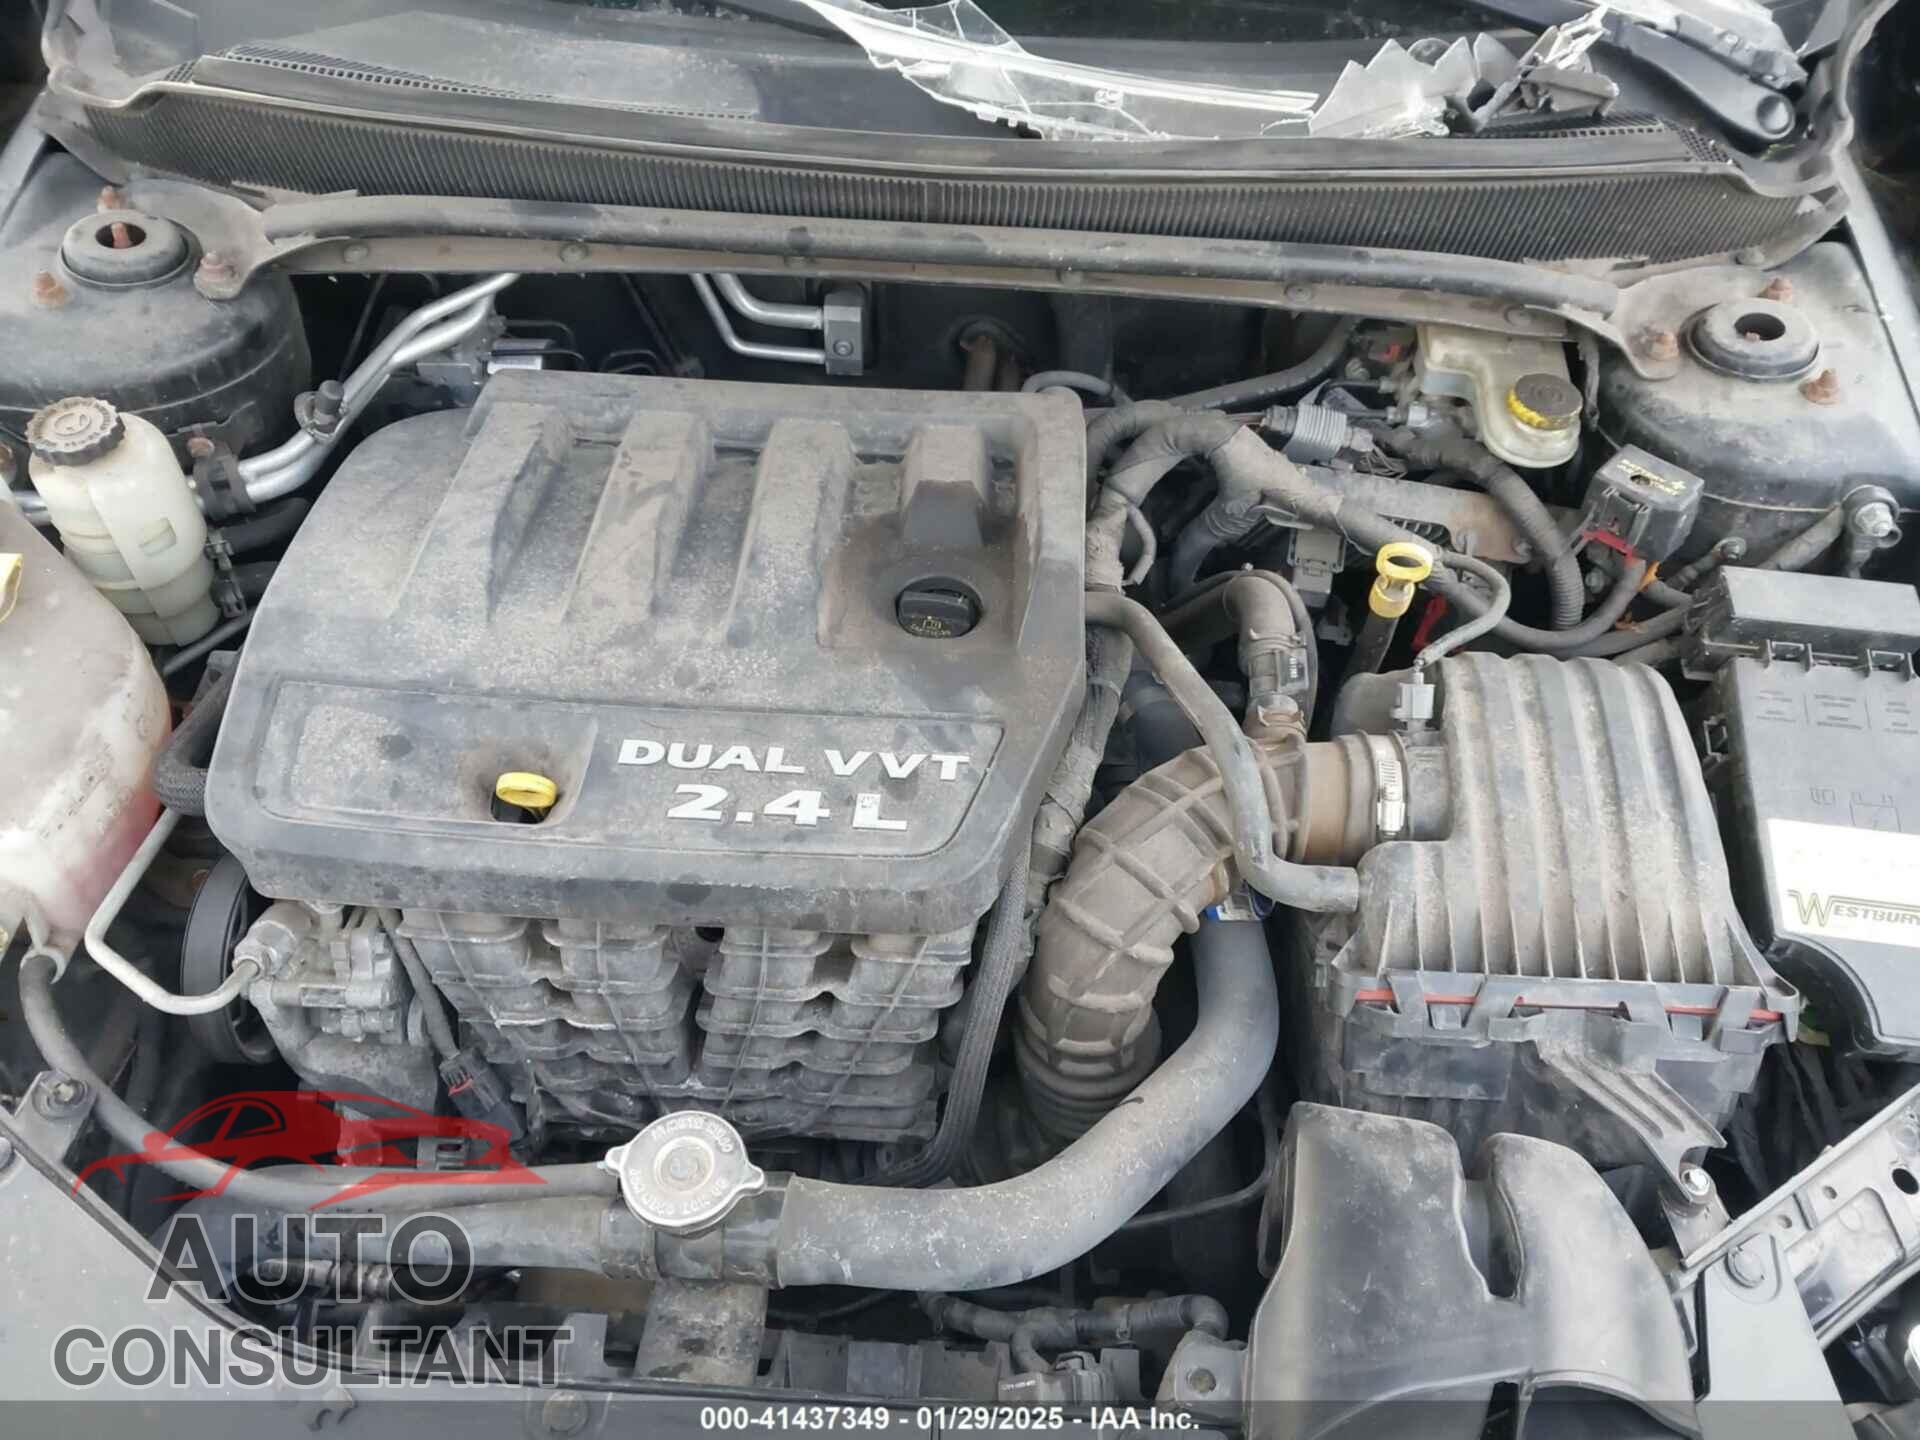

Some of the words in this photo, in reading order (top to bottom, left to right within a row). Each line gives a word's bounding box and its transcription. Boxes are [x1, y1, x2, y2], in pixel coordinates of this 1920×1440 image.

[617, 738, 806, 774] DUAL
[824, 749, 971, 781] VVT
[666, 783, 832, 827] 2.4
[852, 792, 908, 831] L
